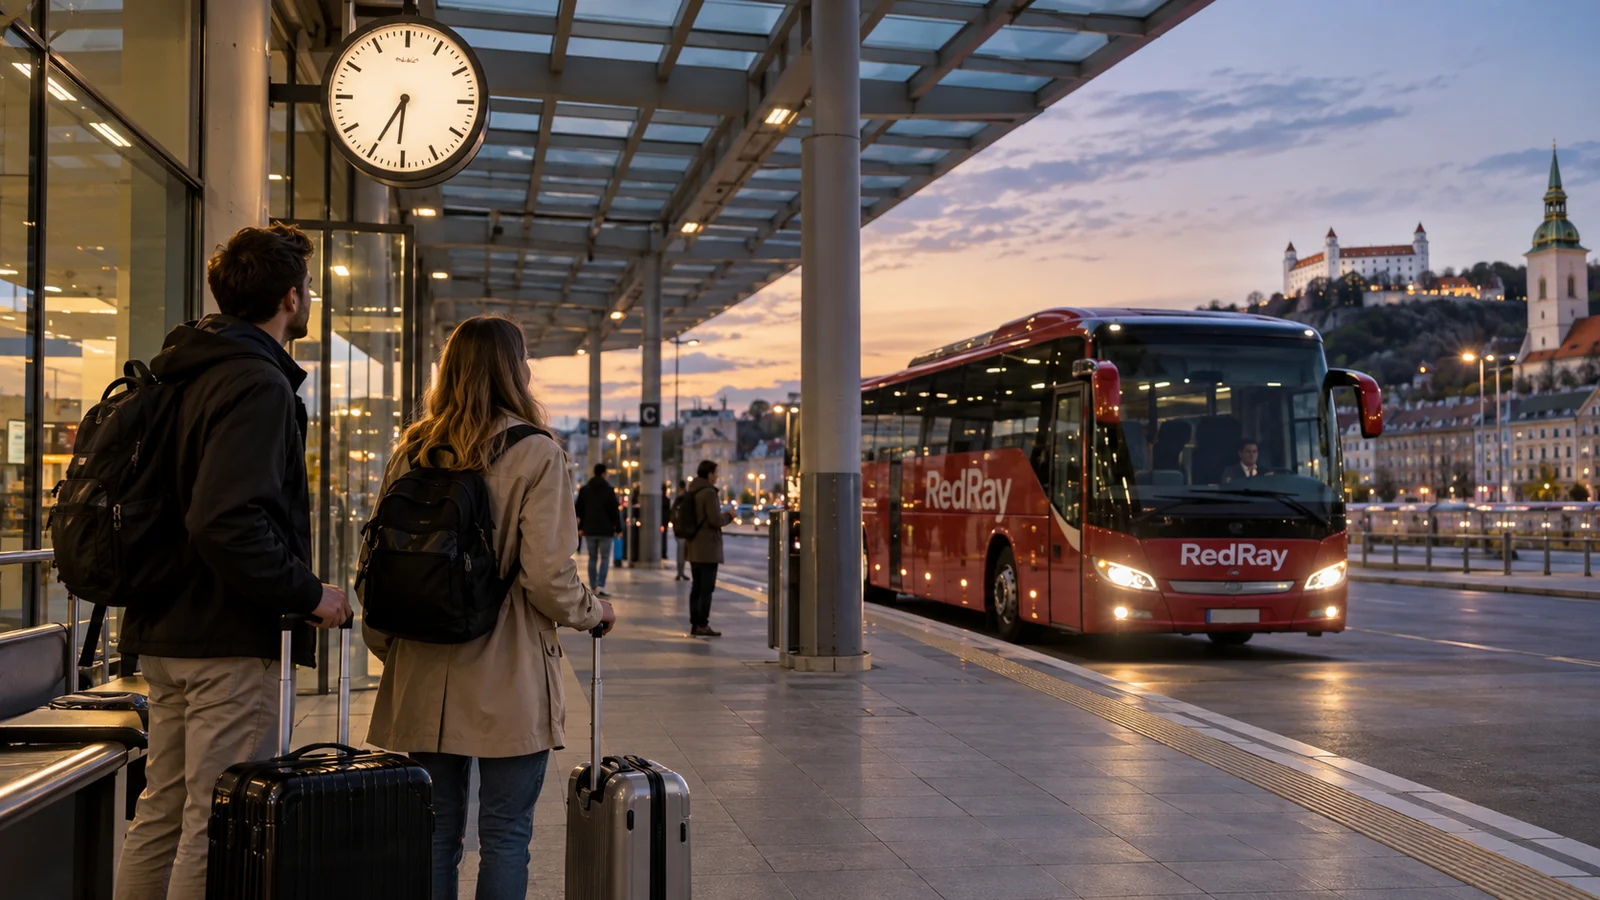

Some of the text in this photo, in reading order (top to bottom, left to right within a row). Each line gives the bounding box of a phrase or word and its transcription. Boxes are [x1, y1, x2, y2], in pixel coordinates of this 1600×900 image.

[643, 406, 656, 424] C
[925, 468, 1012, 523] RedRay
[1180, 543, 1288, 571] RedRay
